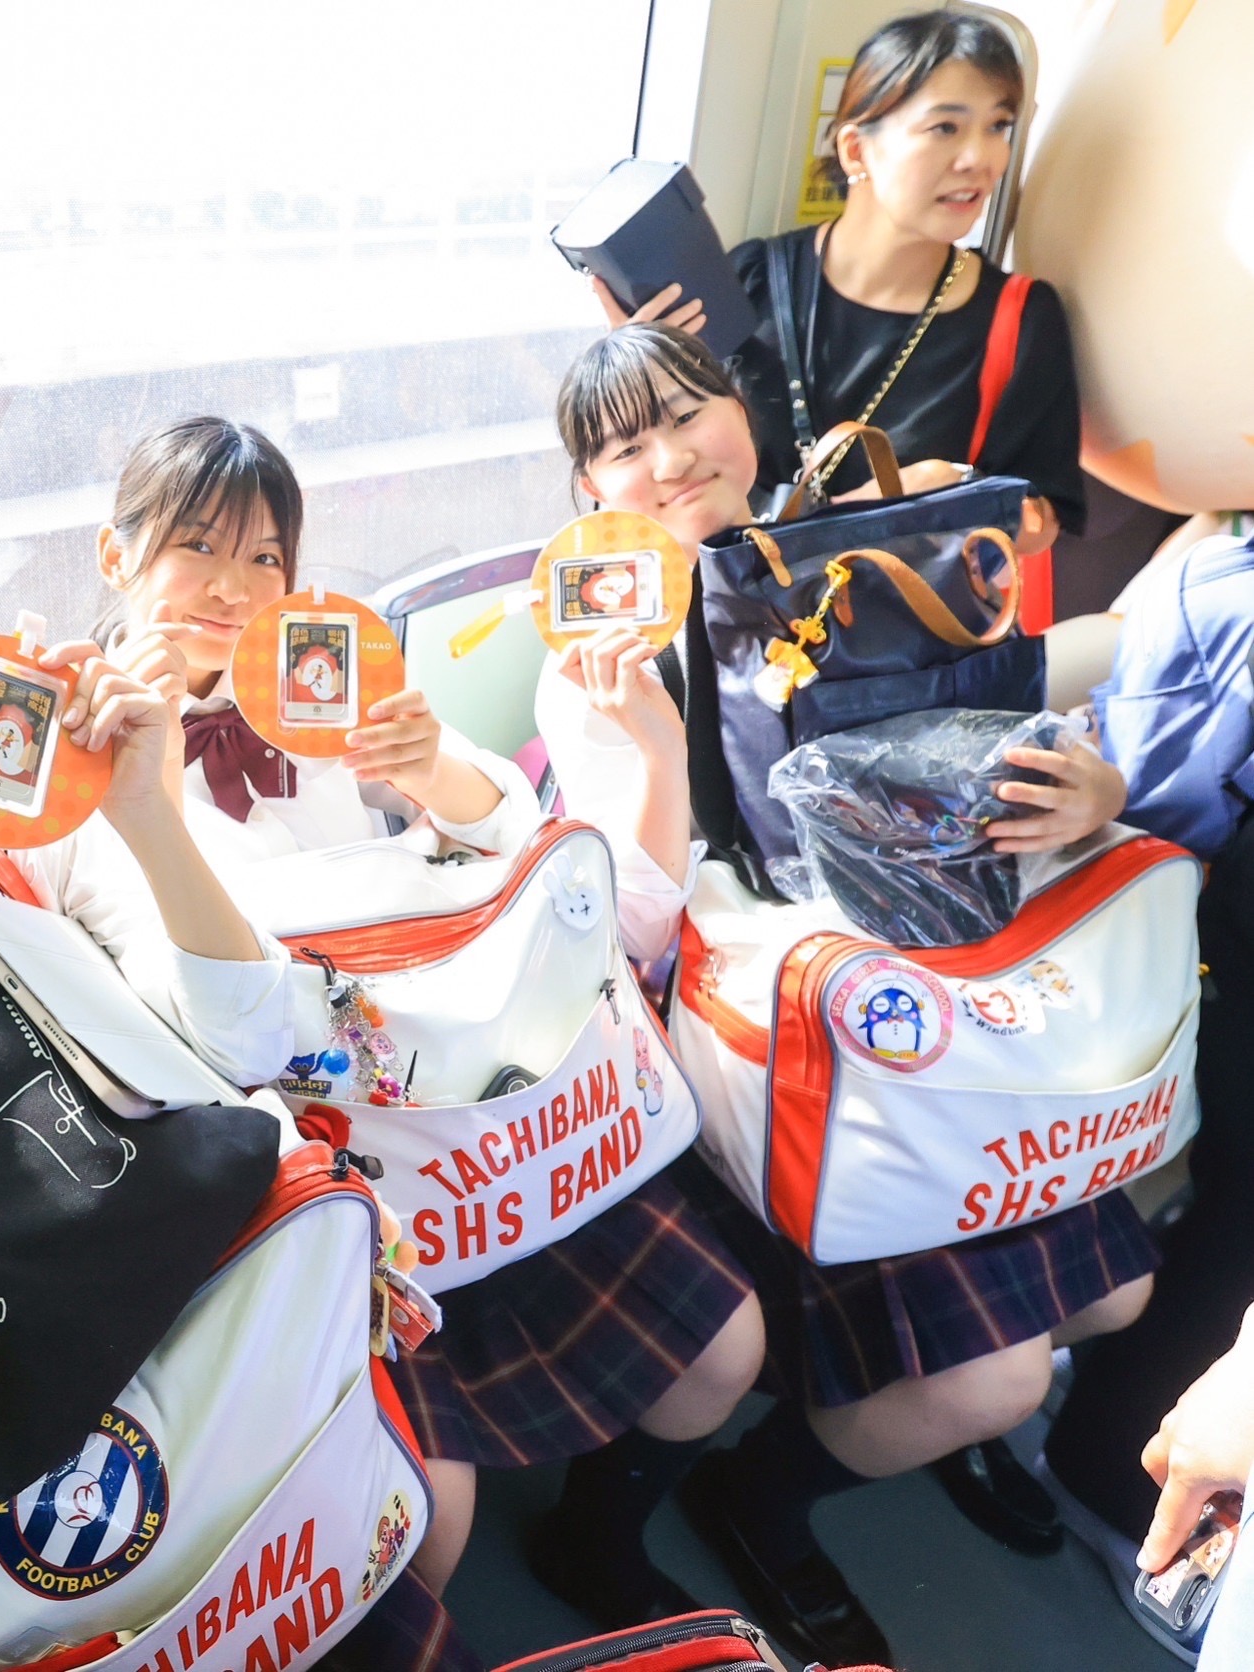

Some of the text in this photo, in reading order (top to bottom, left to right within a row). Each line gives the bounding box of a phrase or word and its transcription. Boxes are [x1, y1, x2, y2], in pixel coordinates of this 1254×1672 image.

[360, 641, 392, 651] TAKAO
[831, 988, 851, 1018] SEIKA
[922, 971, 951, 1012] SCHOOL
[417, 1059, 620, 1200] TACHIBANA
[957, 1123, 1169, 1232] SHS BAND
[982, 1074, 1178, 1178] TACHIBANA
[412, 1105, 642, 1266] SHS BAND
[100, 1412, 148, 1460] BANA
[16, 1512, 160, 1592] FOOTBALL CLUB
[222, 1566, 345, 1672] AND
